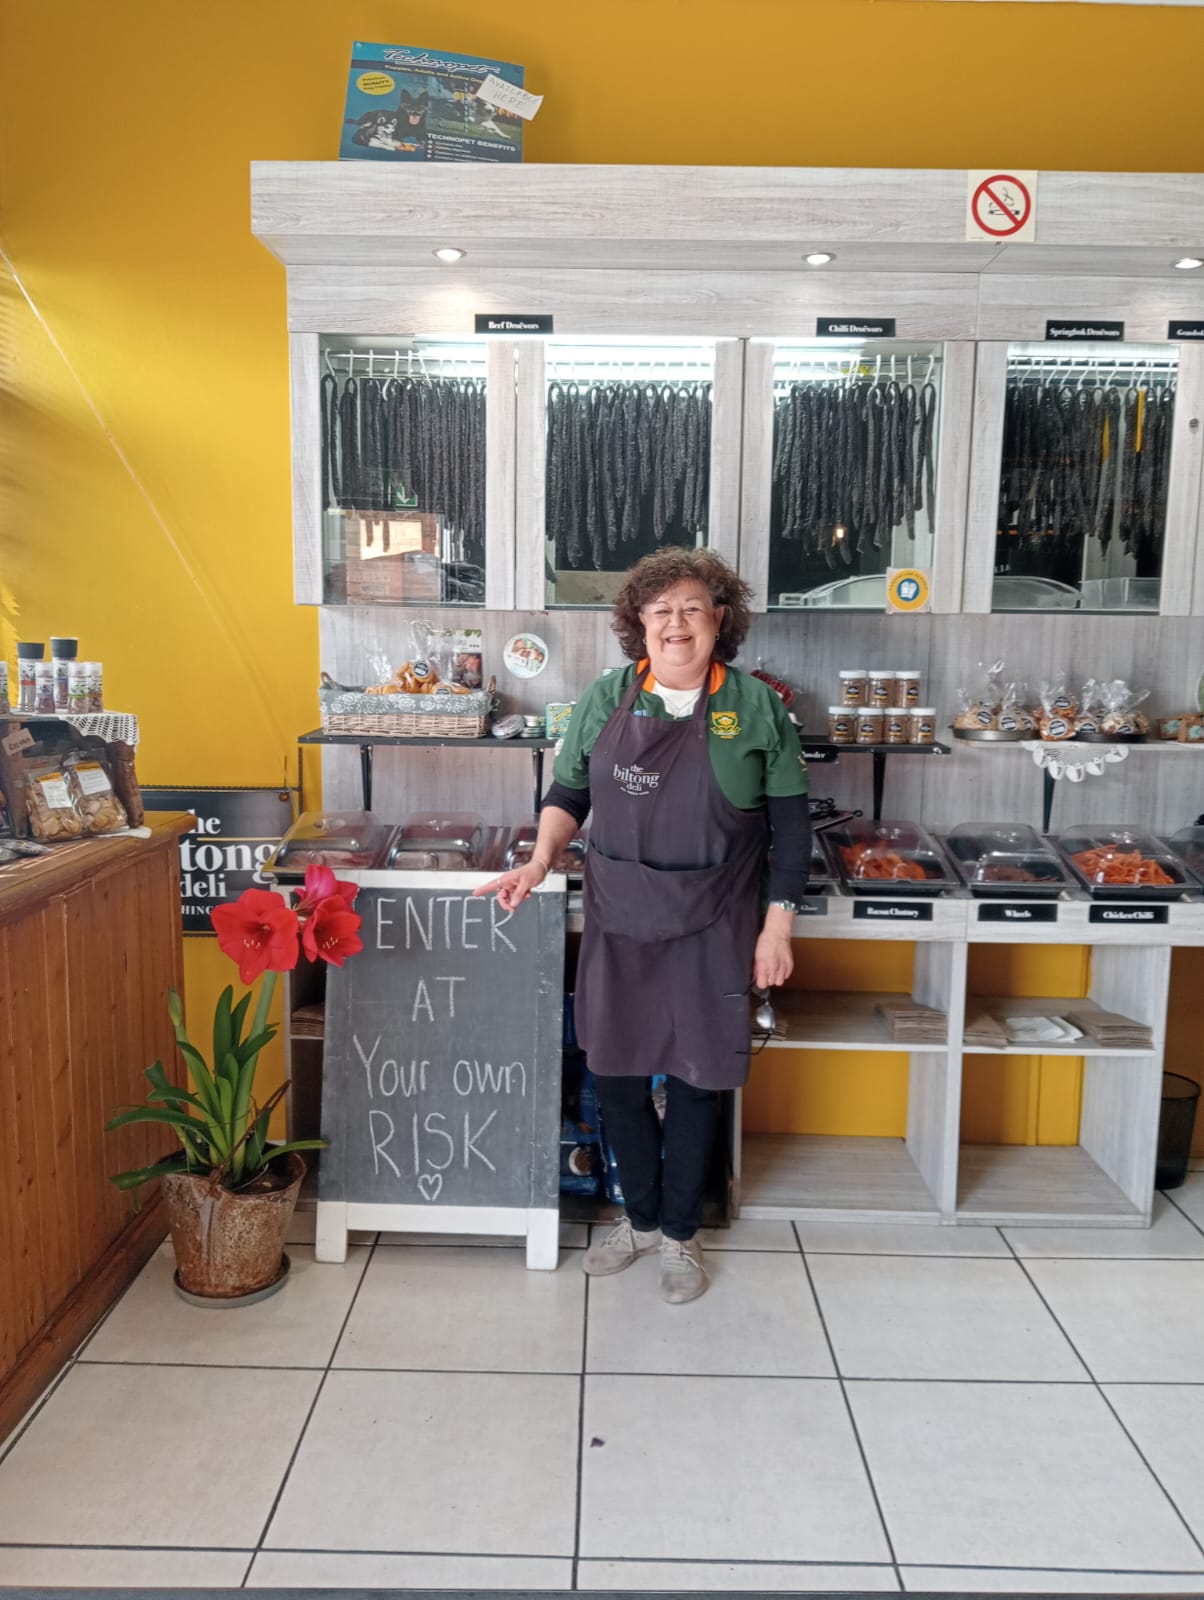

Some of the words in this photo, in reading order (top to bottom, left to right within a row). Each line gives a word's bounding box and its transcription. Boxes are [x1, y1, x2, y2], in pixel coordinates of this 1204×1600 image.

[427, 132, 476, 145] TECHNOPET
[477, 140, 517, 152] BENEFITS
[613, 763, 660, 788] biltong
[630, 764, 644, 772] the
[626, 783, 642, 791] deli
[376, 895, 517, 953] ENTER
[1102, 911, 1132, 919] Chicken
[412, 975, 467, 1023] AT
[353, 1033, 431, 1099] Your
[453, 1058, 527, 1097] own
[368, 1109, 498, 1178] RISK
